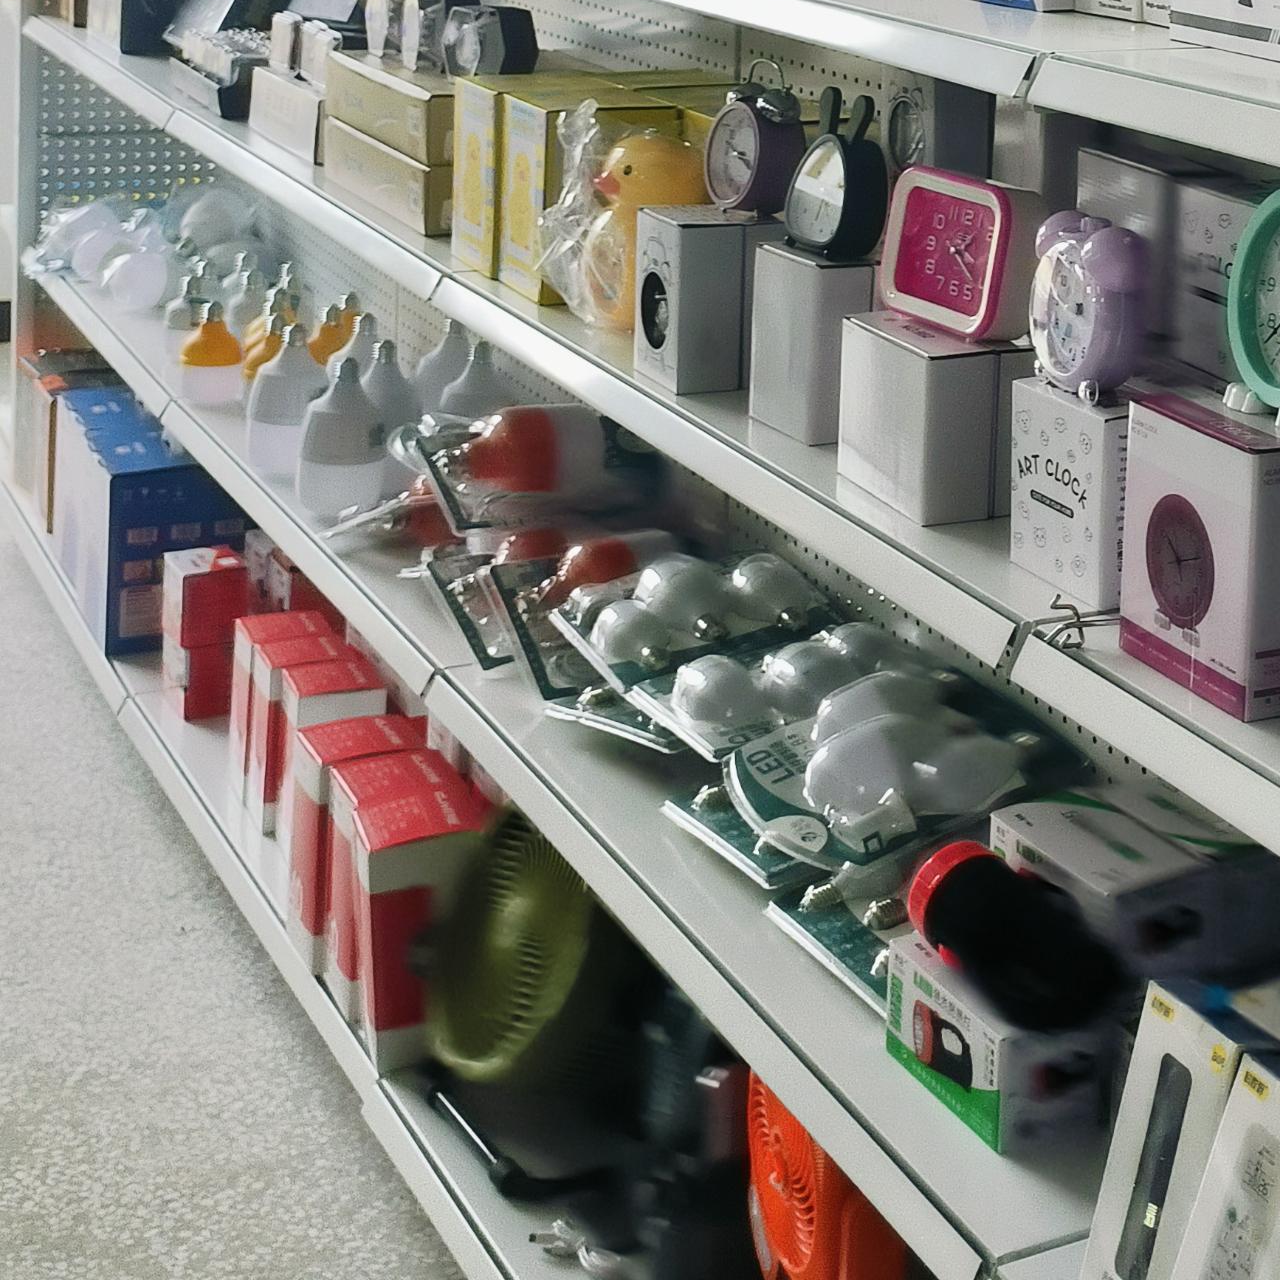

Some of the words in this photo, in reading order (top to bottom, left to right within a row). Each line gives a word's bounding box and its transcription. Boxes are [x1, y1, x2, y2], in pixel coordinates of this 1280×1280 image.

[1017, 454, 1040, 479] ART
[1045, 458, 1087, 509] CLOCK
[747, 750, 795, 784] LED
